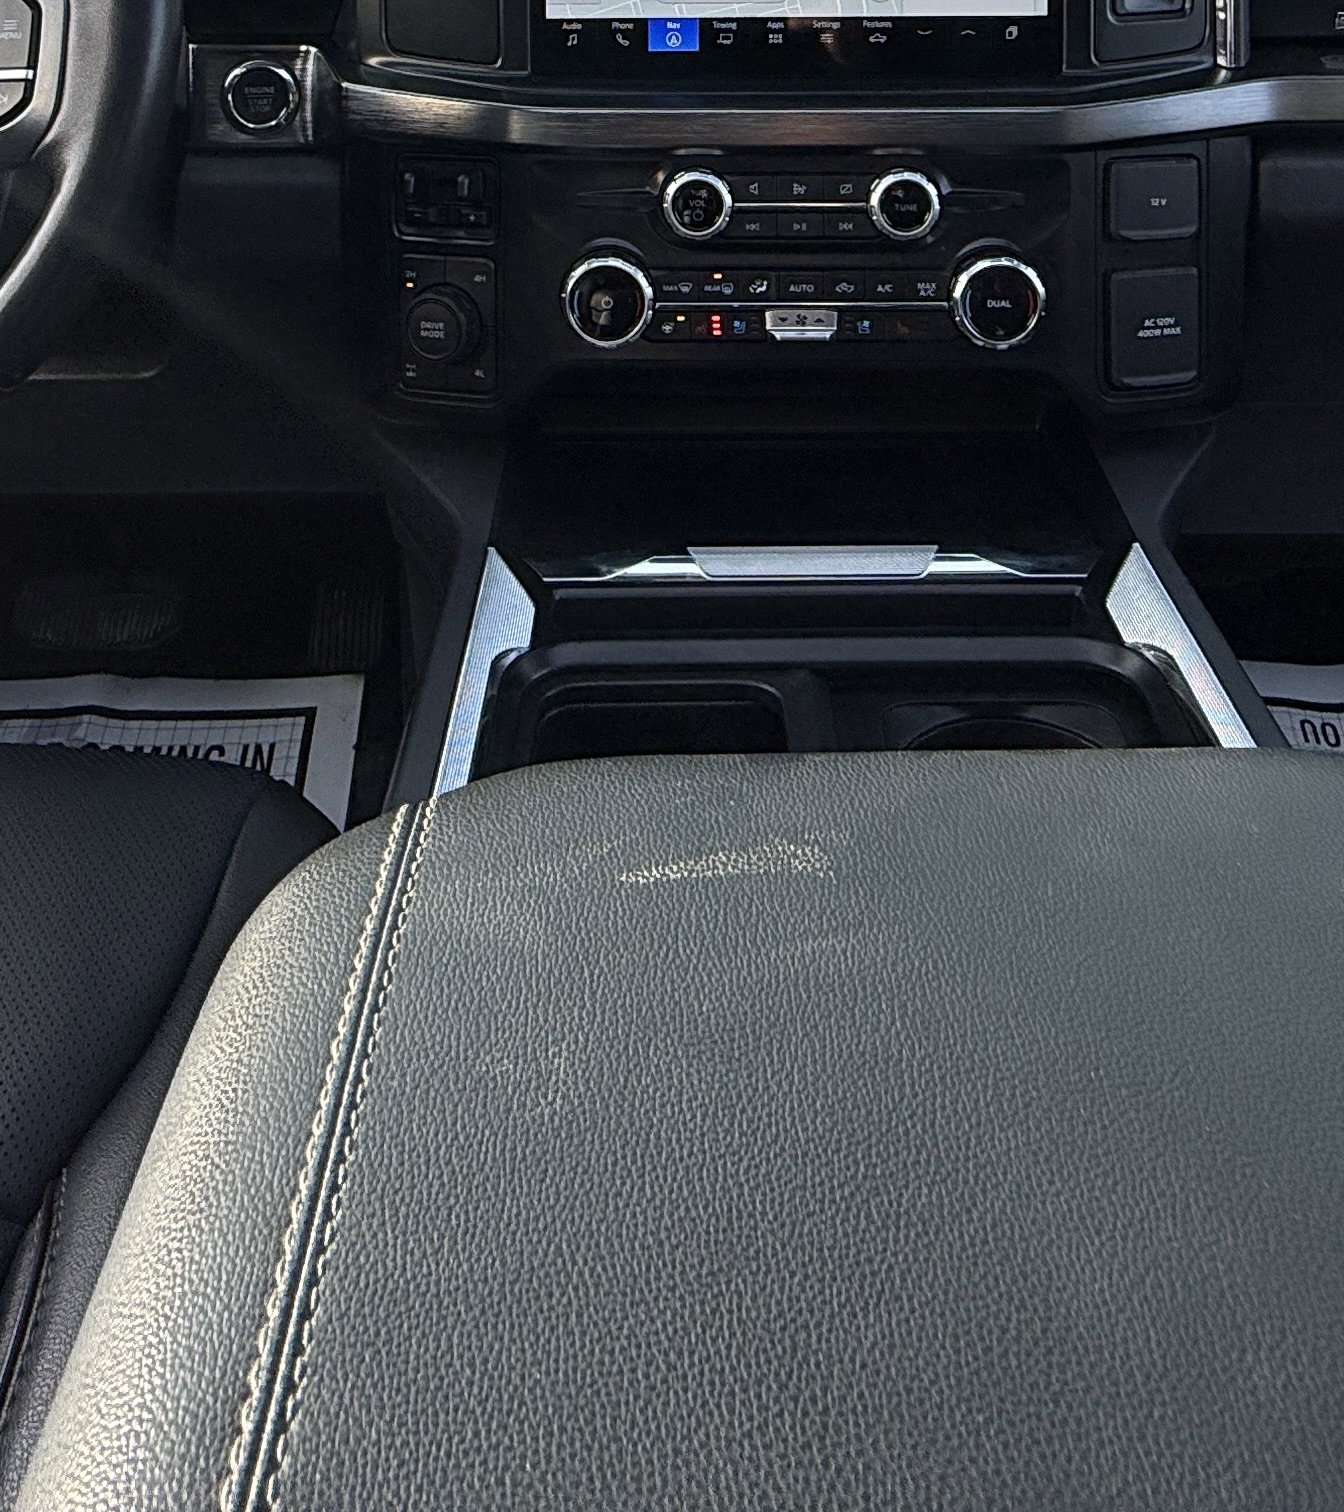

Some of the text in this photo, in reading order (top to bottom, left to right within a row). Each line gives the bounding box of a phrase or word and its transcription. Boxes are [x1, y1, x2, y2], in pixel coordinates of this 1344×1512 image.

[561, 21, 583, 30] Audio
[611, 21, 635, 30] Phone
[666, 21, 681, 30] Nav
[712, 20, 738, 31] Towing
[766, 20, 785, 31] Apps
[812, 19, 841, 30] Settings
[862, 19, 893, 29] Features
[688, 199, 706, 208] VOL
[894, 203, 918, 213] TUNE
[473, 274, 487, 283] 4H
[788, 284, 815, 293] AUTO
[876, 283, 894, 293] A/C
[917, 281, 937, 290] MAX
[919, 288, 935, 298] A/C
[986, 298, 1013, 309] DUAL
[420, 320, 445, 330] DRIVE
[1143, 318, 1155, 327] AC
[420, 330, 445, 340] MODE
[1163, 325, 1182, 336] MAX
